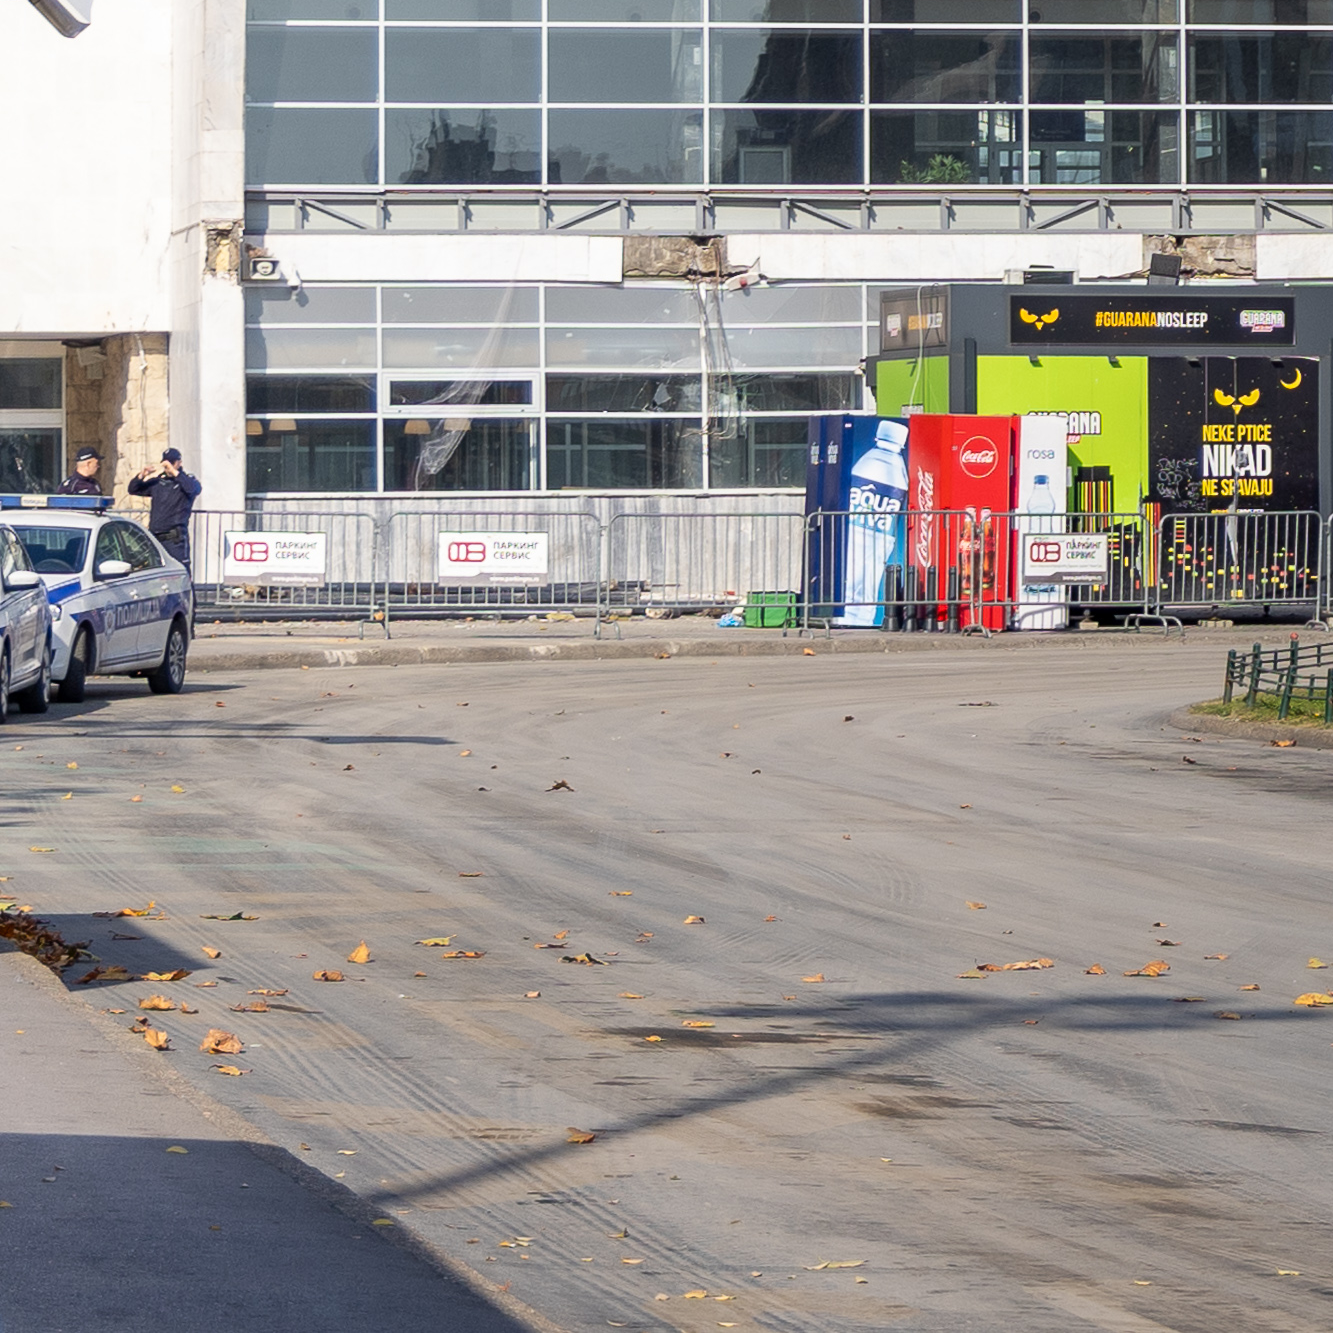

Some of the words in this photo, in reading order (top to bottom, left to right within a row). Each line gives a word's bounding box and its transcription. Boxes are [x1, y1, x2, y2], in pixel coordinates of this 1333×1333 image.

[1096, 311, 1208, 328] #GUARANANOSLEEP
[1202, 424, 1235, 442] NEKE
[1237, 424, 1272, 442] PTICE
[1027, 449, 1055, 460] rosa
[1202, 479, 1218, 496] NE
[275, 541, 317, 550] ПАРКИНГ
[493, 541, 538, 550] ПАРКИНГ
[1066, 541, 1102, 550] ПАРКИНГ
[275, 551, 310, 560] СЕРВИС
[493, 551, 531, 560] СЕРВИС
[1066, 550, 1096, 559] СЕРВИС
